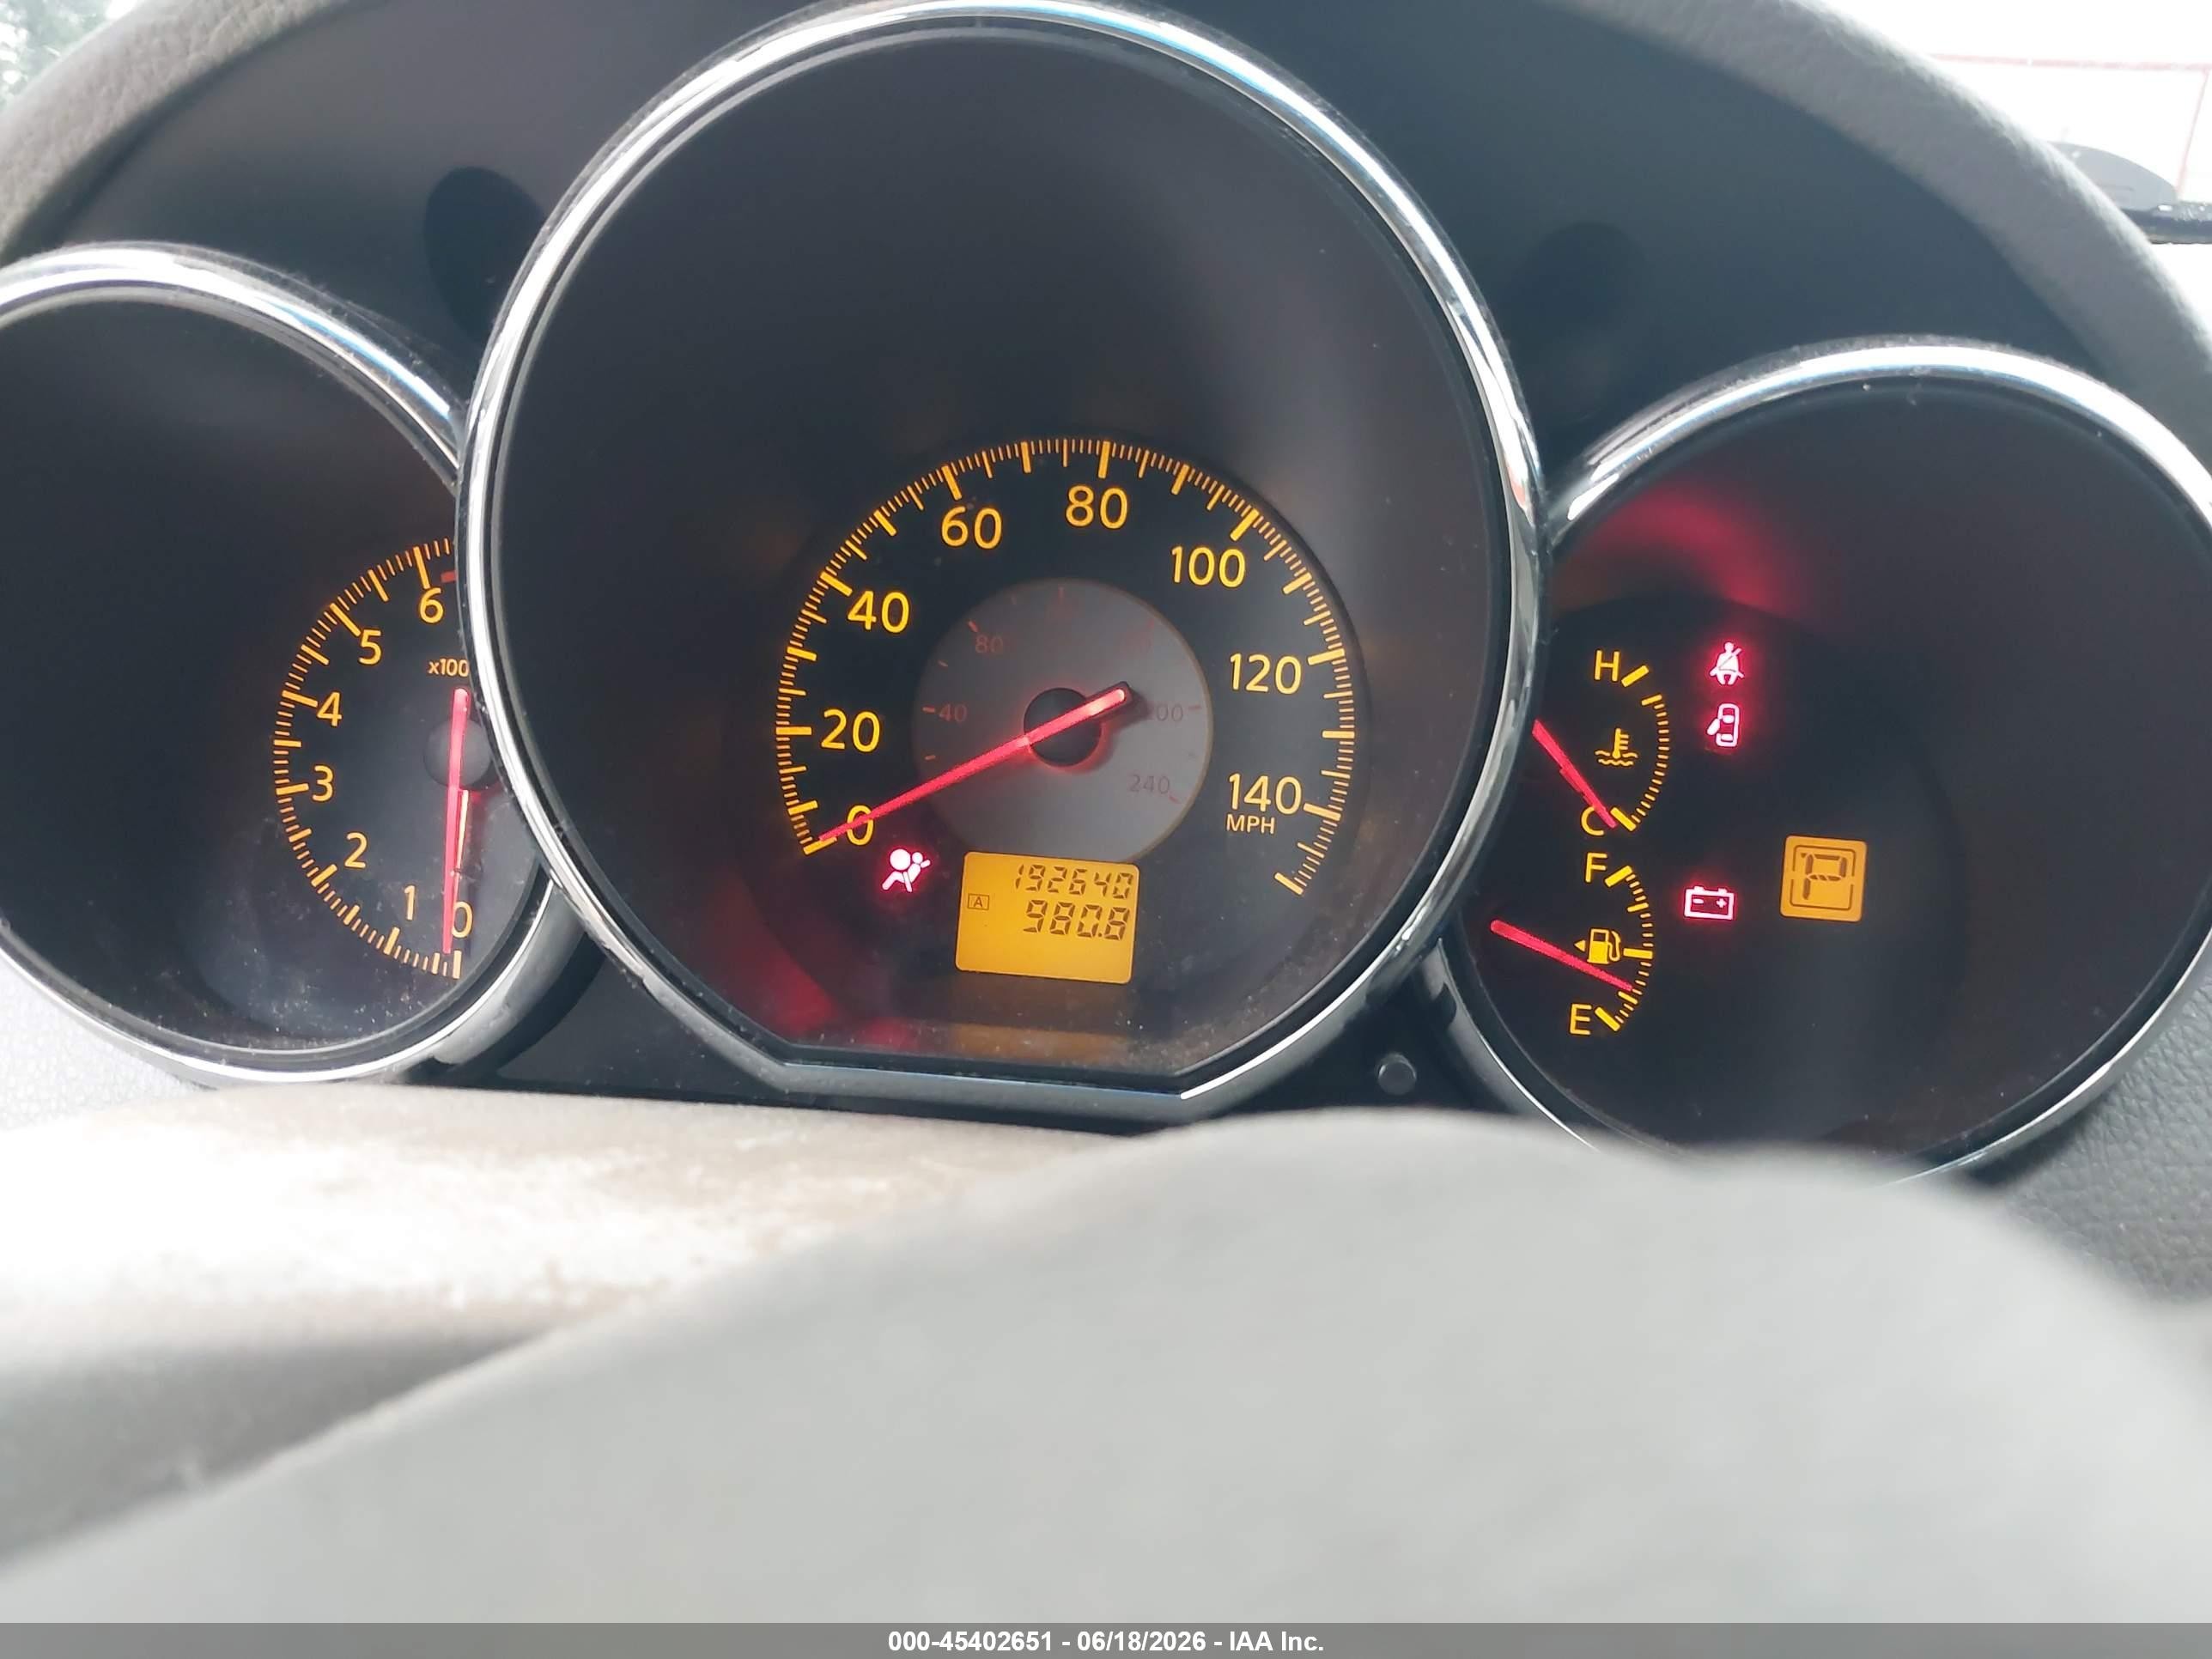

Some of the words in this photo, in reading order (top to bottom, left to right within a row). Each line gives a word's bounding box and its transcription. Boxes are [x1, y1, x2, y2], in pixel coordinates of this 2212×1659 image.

[1066, 485, 1127, 528] 80
[941, 507, 1002, 549] 60
[1171, 545, 1245, 587] 100
[419, 588, 443, 623] 6
[848, 591, 909, 633] 40
[358, 630, 381, 665] 5
[975, 635, 1003, 653] 80
[1231, 653, 1302, 694] 120
[1594, 650, 1620, 682] H
[316, 692, 342, 726] 4
[939, 704, 967, 721] 40
[821, 708, 880, 752] 20
[312, 766, 333, 802] 3
[1129, 774, 1170, 794] 240
[1229, 773, 1302, 815] 140
[847, 805, 874, 845] 0
[1226, 813, 1275, 835] MPH
[1581, 806, 1604, 836] C
[344, 832, 367, 869] 2
[1585, 852, 1608, 883] F
[1015, 864, 1133, 899] 192640
[1802, 852, 1848, 900] P
[404, 885, 416, 921] 1
[452, 901, 473, 938] 0
[973, 896, 983, 908] A
[1024, 899, 1130, 941] 980.8
[1569, 1003, 1592, 1036] E
